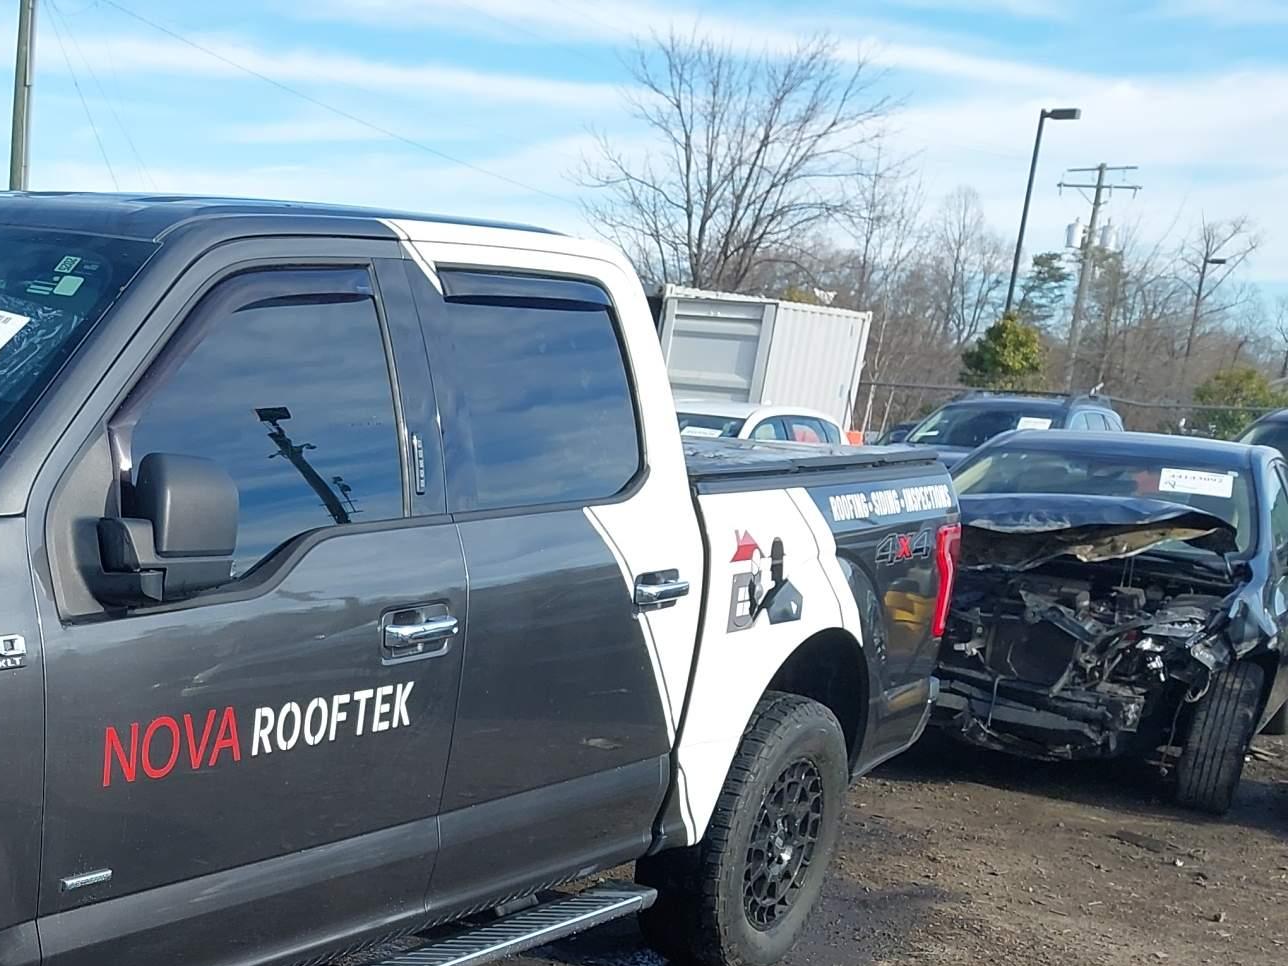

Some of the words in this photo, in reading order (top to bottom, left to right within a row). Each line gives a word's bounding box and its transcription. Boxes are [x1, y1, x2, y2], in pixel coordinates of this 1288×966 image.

[828, 492, 870, 522] ROOFING
[870, 489, 901, 517] SIDING
[902, 484, 952, 513] INSPECTIONS
[102, 705, 242, 788] NOVA
[250, 680, 415, 757] ROOFTEK
